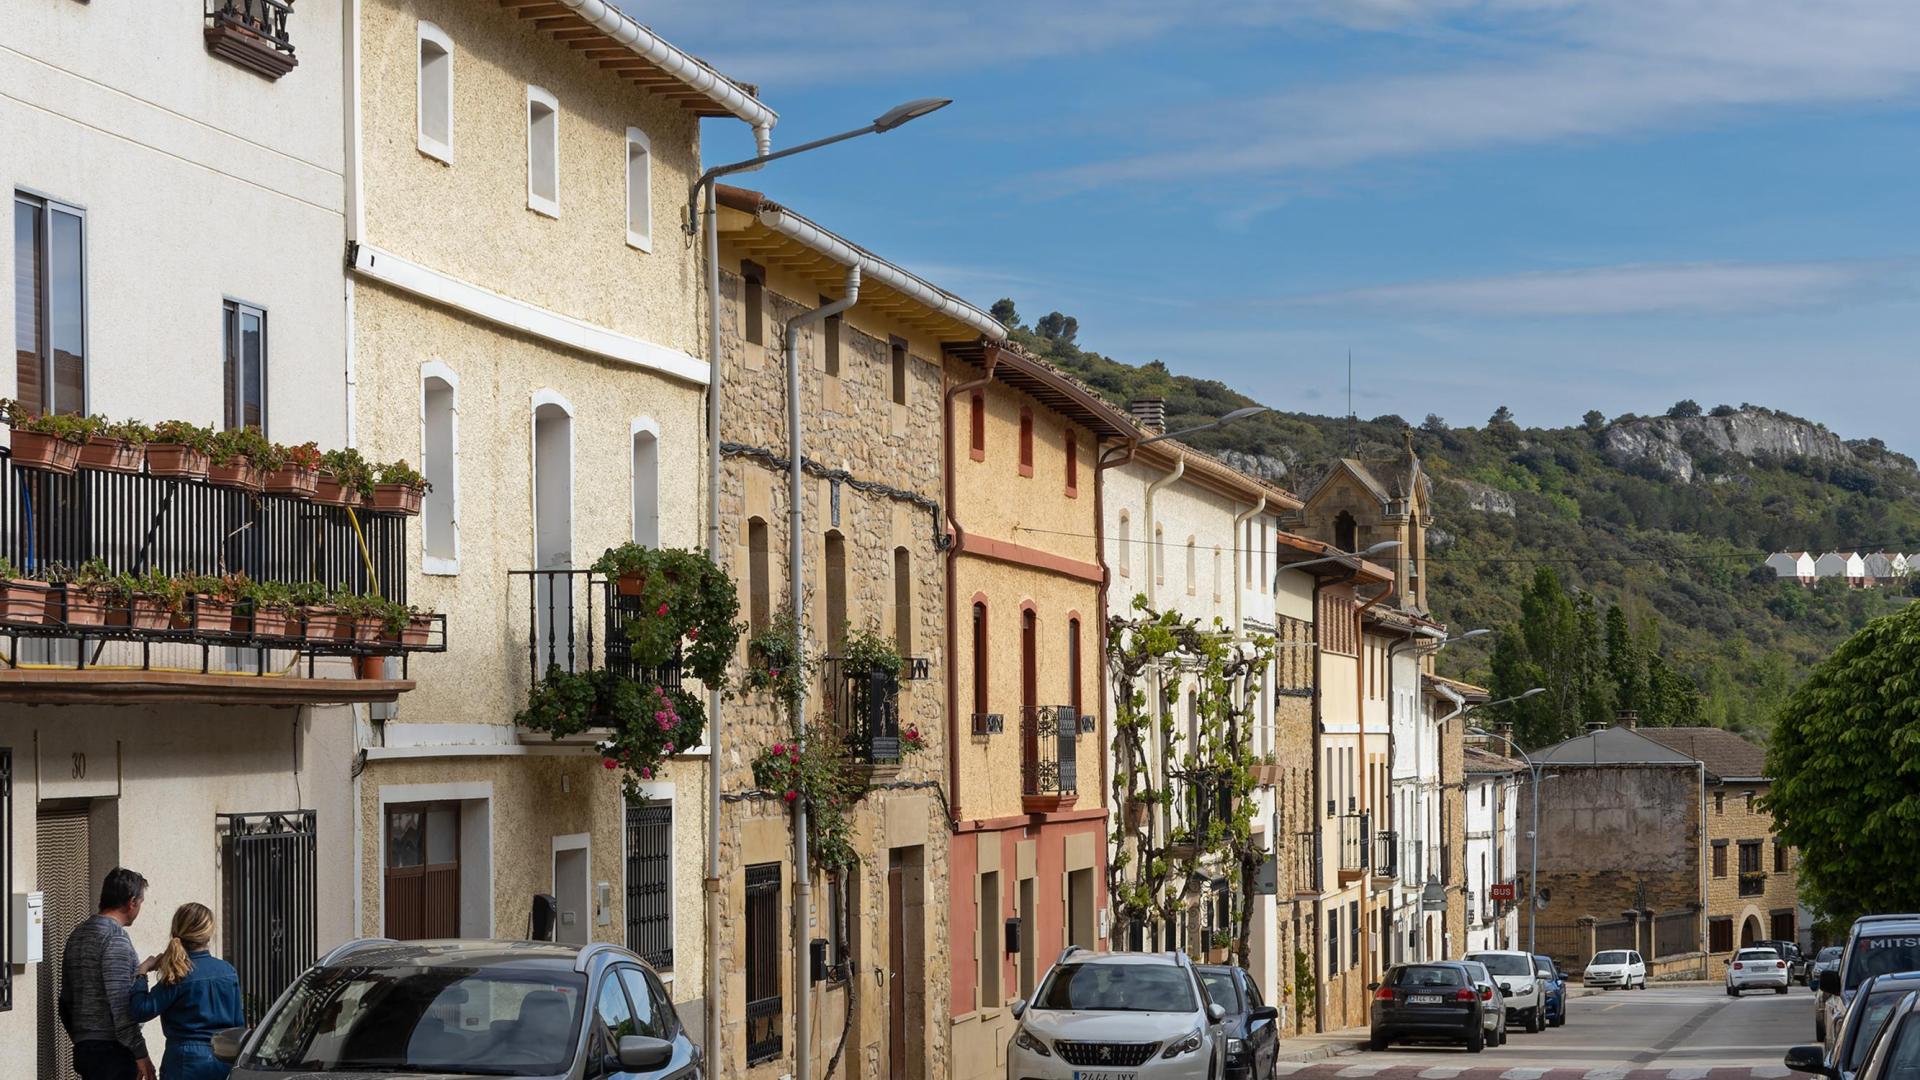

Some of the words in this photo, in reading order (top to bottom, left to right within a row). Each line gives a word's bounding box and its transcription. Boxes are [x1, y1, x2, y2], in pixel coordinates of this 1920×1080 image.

[71, 752, 86, 779] 30
[1493, 888, 1511, 896] BUS
[1870, 938, 1920, 949] MITS
